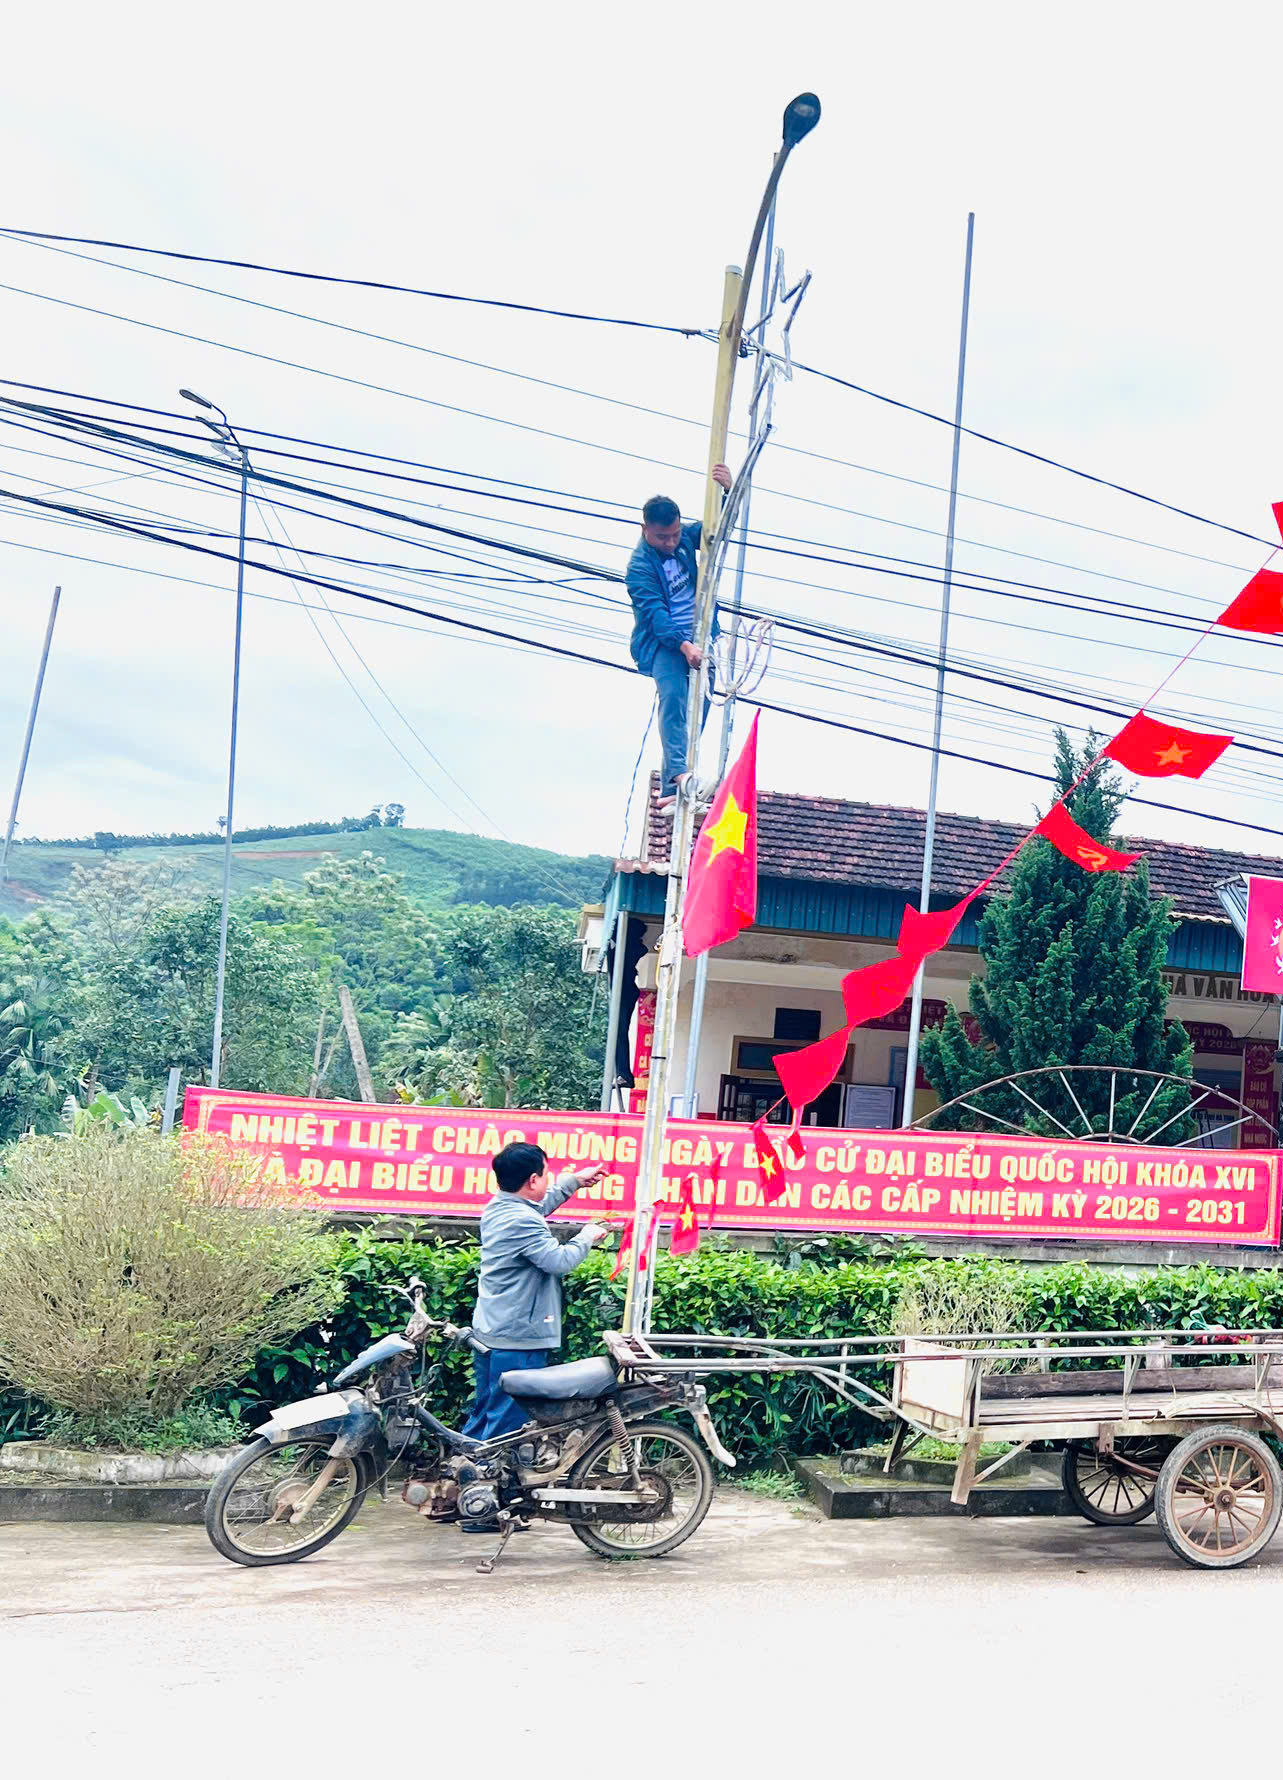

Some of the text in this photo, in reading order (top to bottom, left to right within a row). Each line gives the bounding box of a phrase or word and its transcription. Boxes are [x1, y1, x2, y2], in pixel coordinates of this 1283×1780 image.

[230, 1113, 339, 1151] NHIỆT
[349, 1118, 423, 1155] LIỆT
[537, 1128, 637, 1162] MỪNG
[815, 1140, 861, 1173] CỬ
[865, 1149, 916, 1180] ĐẠI
[924, 1144, 991, 1179] BIỂU
[1000, 1150, 1074, 1183] QUỐC
[1083, 1156, 1127, 1190] HỘI
[1136, 1159, 1206, 1188] KHÓA
[1214, 1166, 1255, 1191] XVI
[298, 1158, 361, 1193] ĐẠI
[371, 1154, 453, 1194] BIỂU
[636, 1172, 727, 1206] HN
[735, 1178, 802, 1208] DN
[811, 1176, 872, 1212] CÁC
[881, 1179, 940, 1212] CẤP
[950, 1186, 1043, 1221] NHIỆM
[1051, 1189, 1088, 1218] KỲ
[1095, 1195, 1160, 1221] 2026
[1186, 1199, 1245, 1225] 2031
